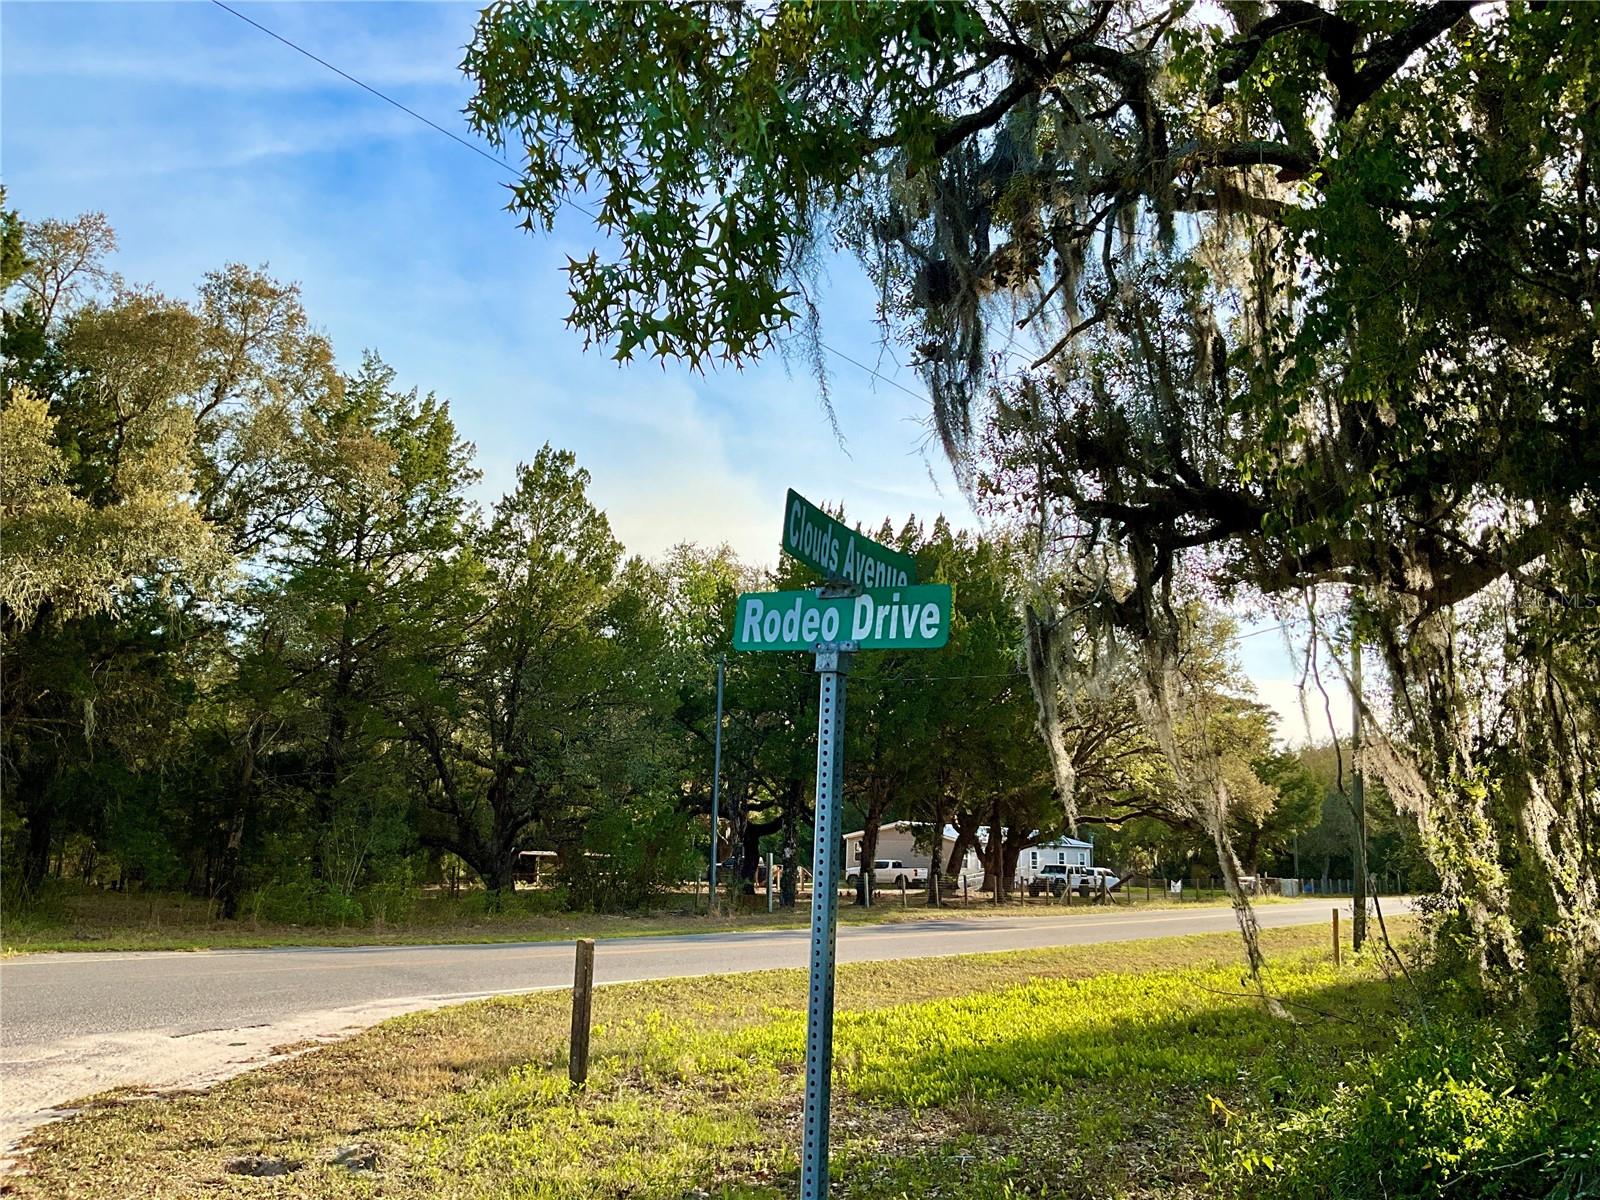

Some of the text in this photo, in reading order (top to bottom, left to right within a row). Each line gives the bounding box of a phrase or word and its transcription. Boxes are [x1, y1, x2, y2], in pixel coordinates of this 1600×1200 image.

[789, 499, 908, 588] Clouds Avenue
[741, 592, 941, 643] Rodeo Drive
